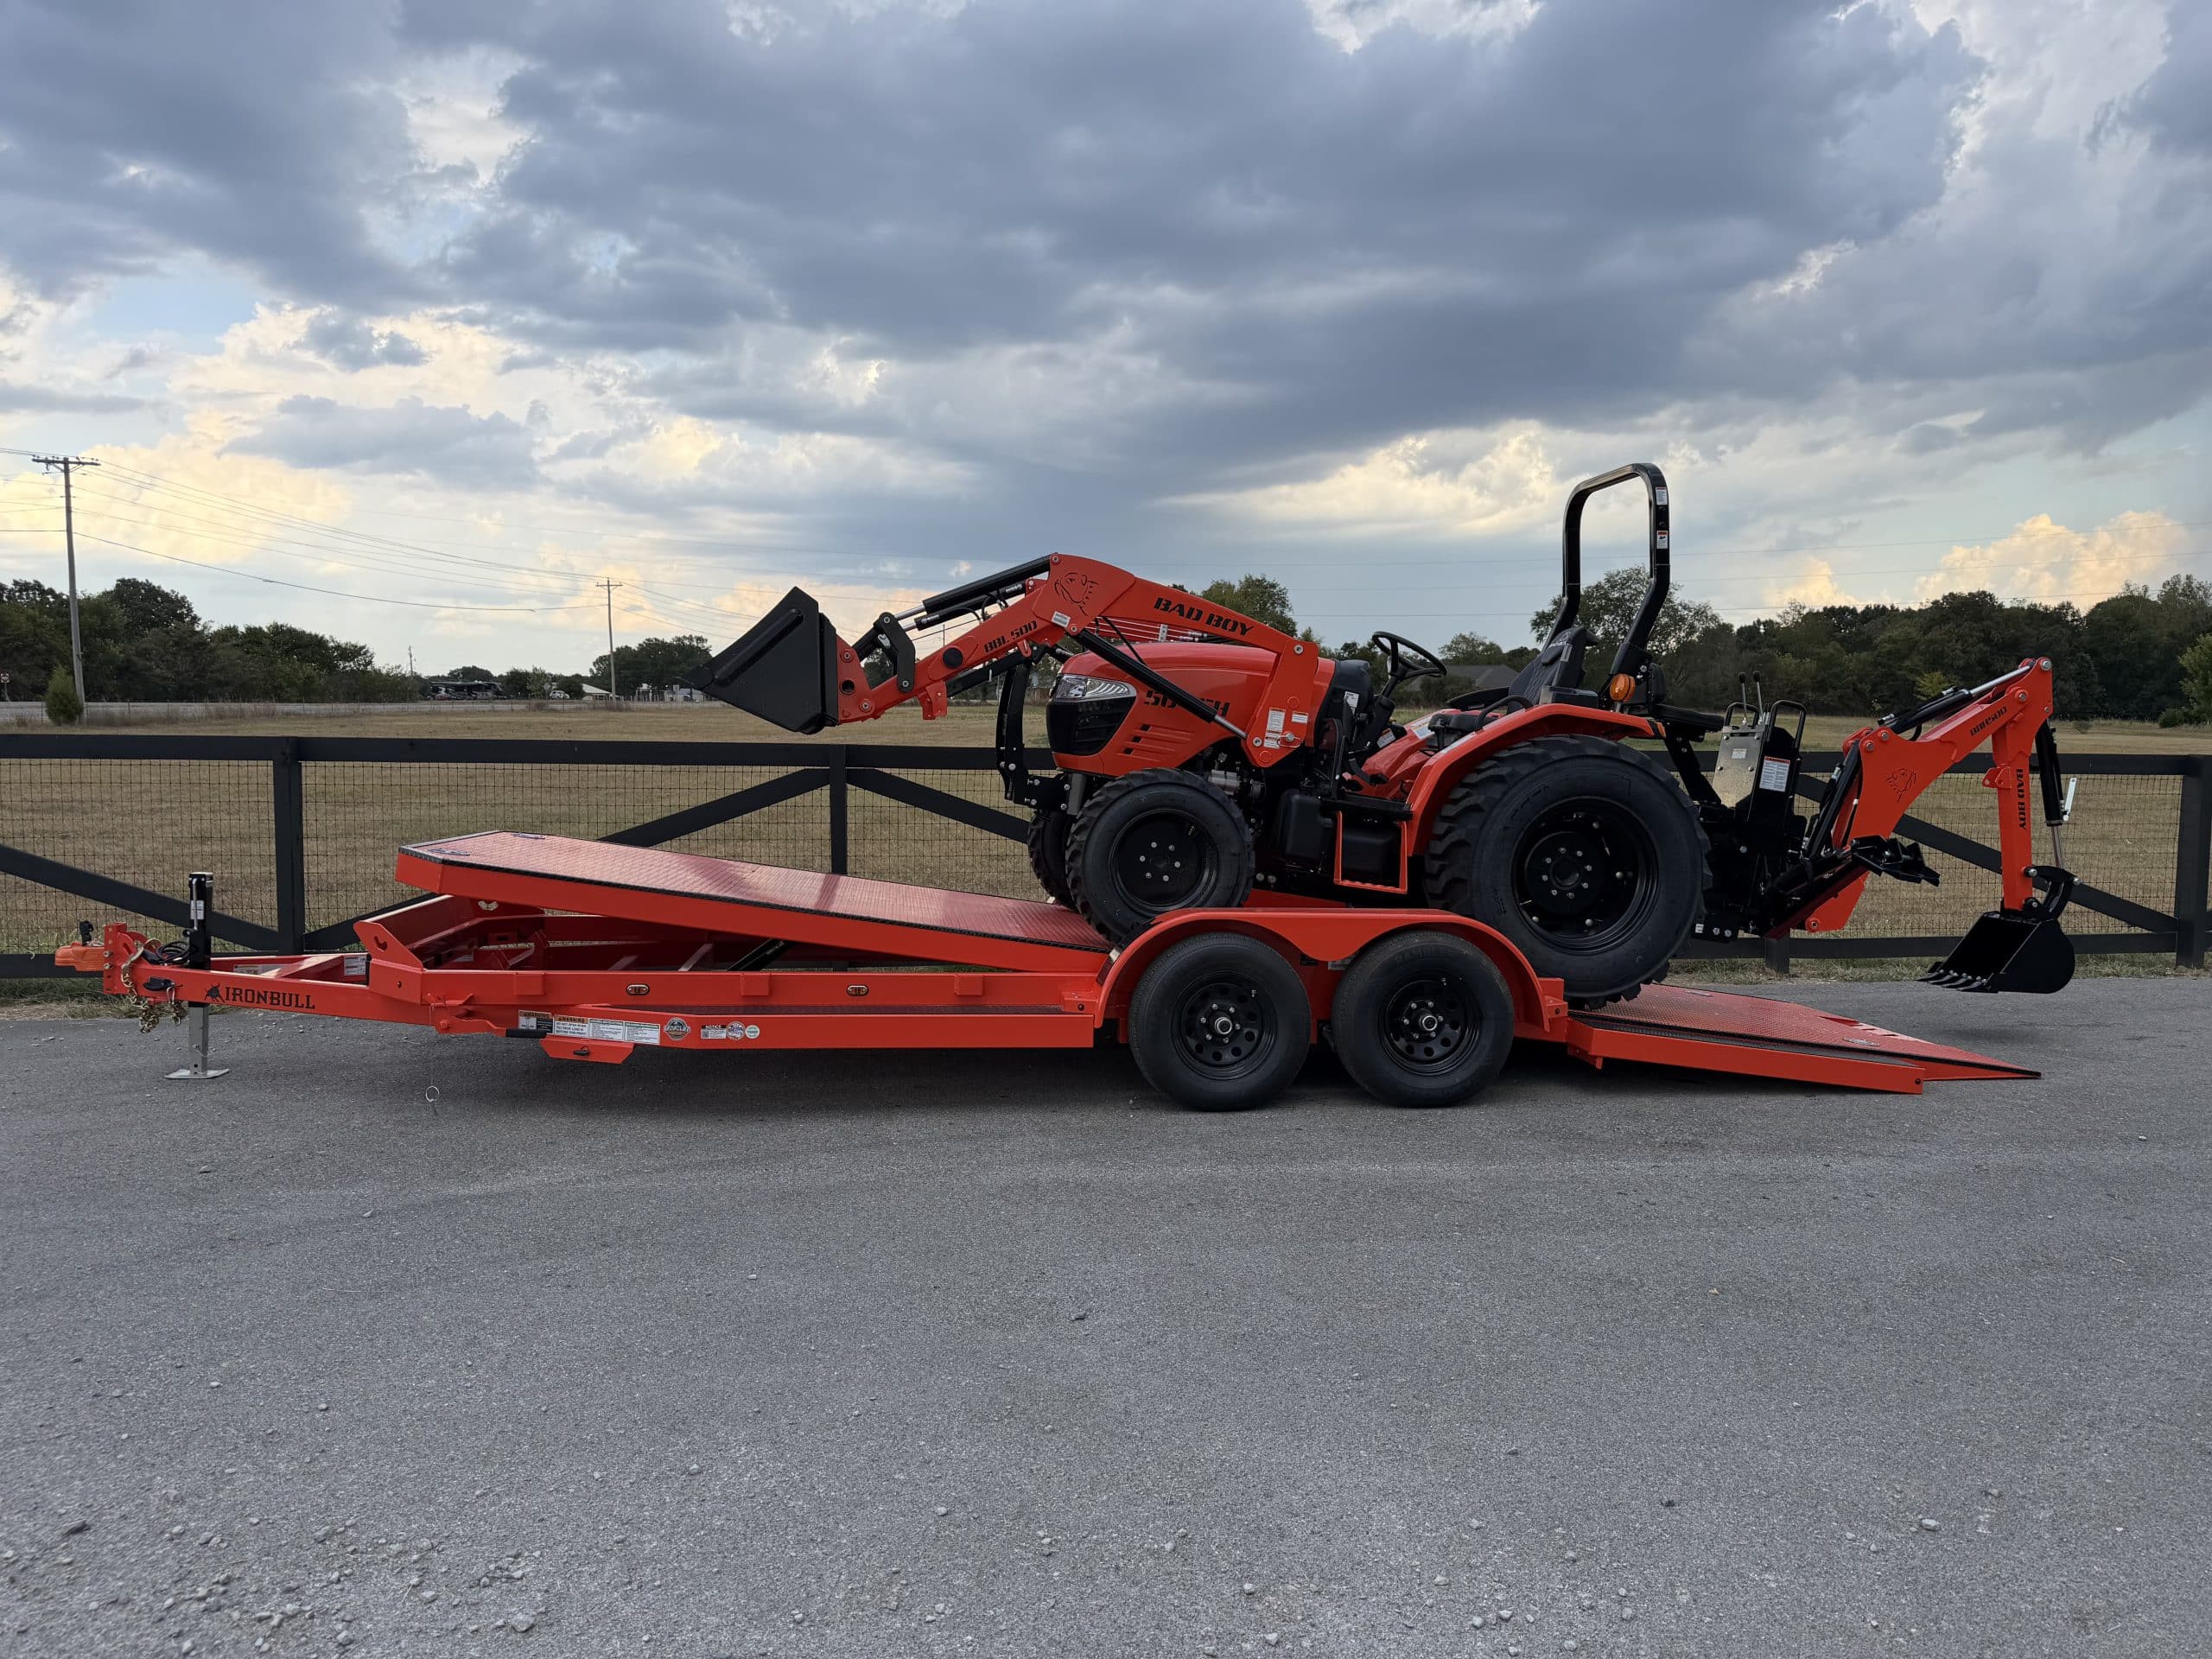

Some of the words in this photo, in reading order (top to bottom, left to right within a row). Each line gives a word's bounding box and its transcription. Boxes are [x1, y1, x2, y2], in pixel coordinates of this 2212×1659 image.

[1010, 620, 1037, 639] 500
[1154, 597, 1204, 622] BAD
[1205, 613, 1255, 636] BOY
[2016, 768, 2025, 798] BAD
[2018, 801, 2027, 830] BOY
[225, 986, 315, 1009] IRONBULL
